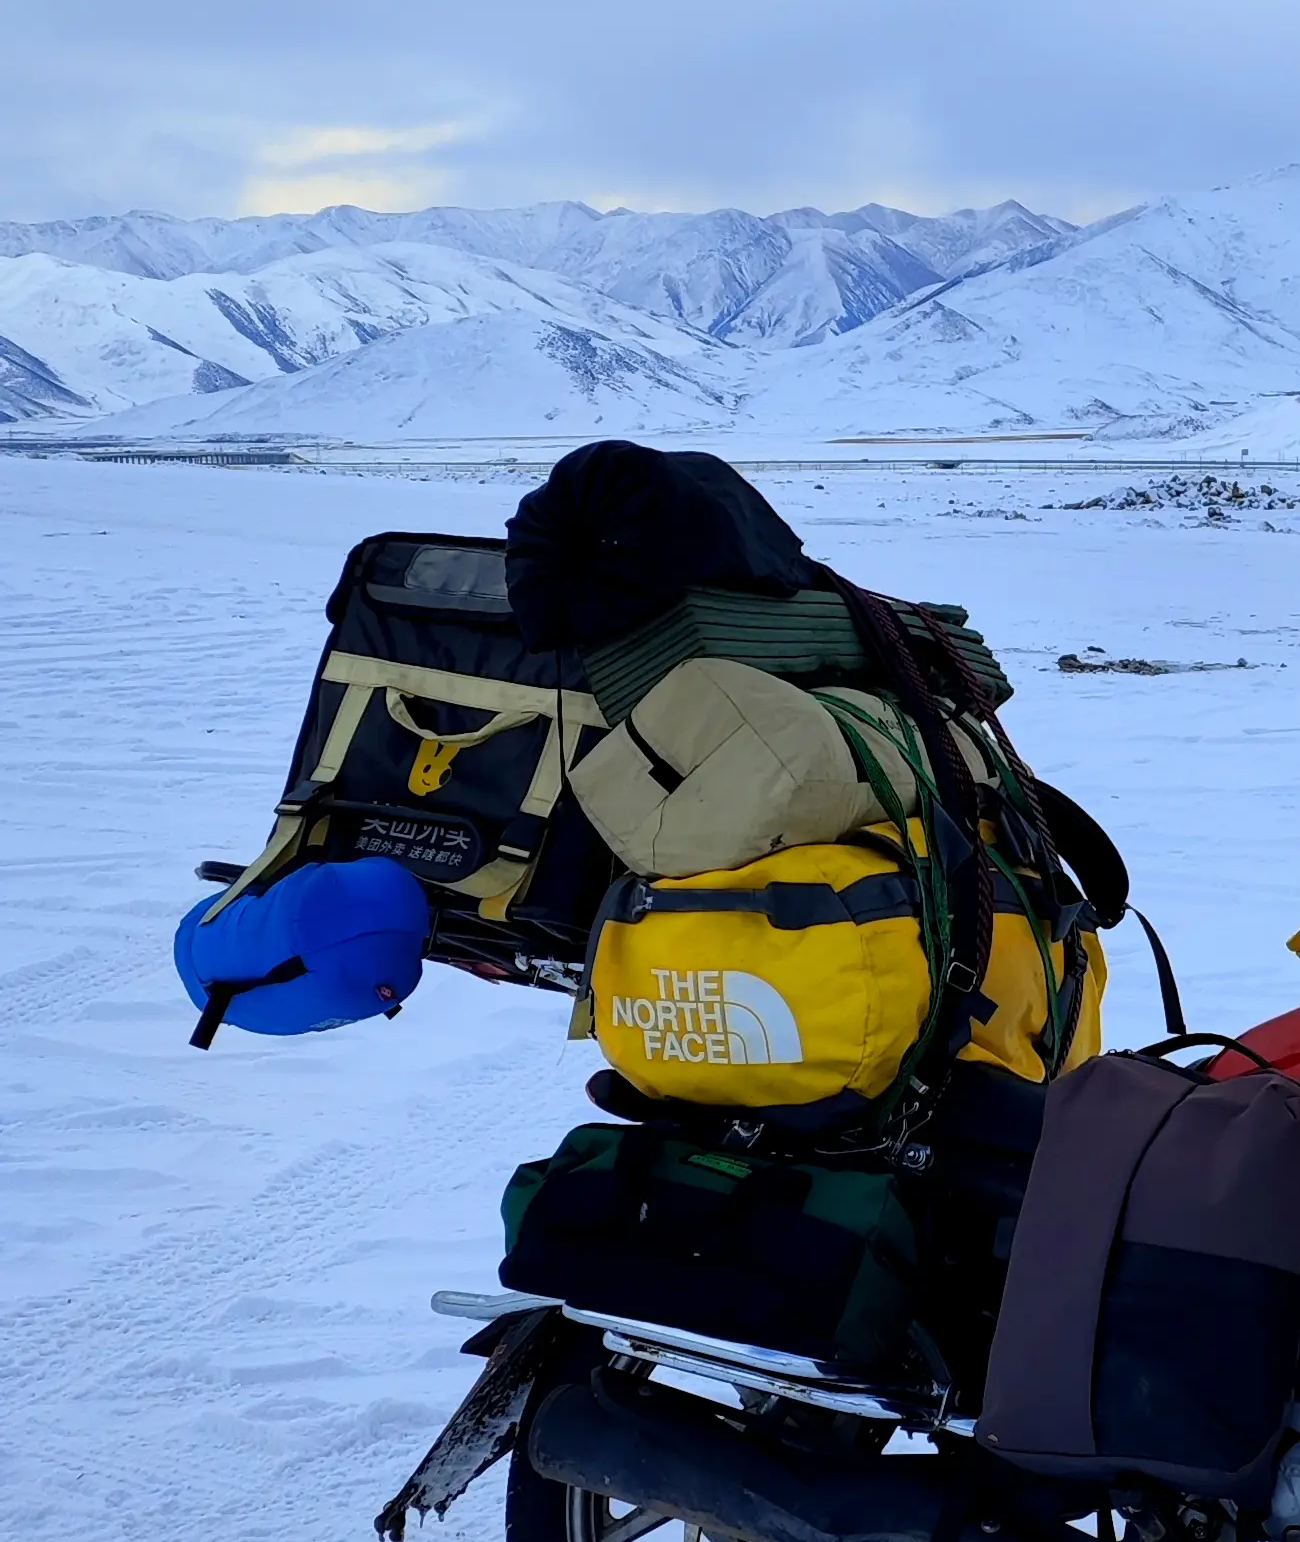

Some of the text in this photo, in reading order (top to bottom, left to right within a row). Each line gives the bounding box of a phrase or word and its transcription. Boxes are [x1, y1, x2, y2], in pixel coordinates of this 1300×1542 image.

[354, 835, 407, 856] 美团外卖
[650, 968, 721, 1002] THE
[612, 996, 724, 1033] NORTH
[643, 1031, 729, 1064] FACE
